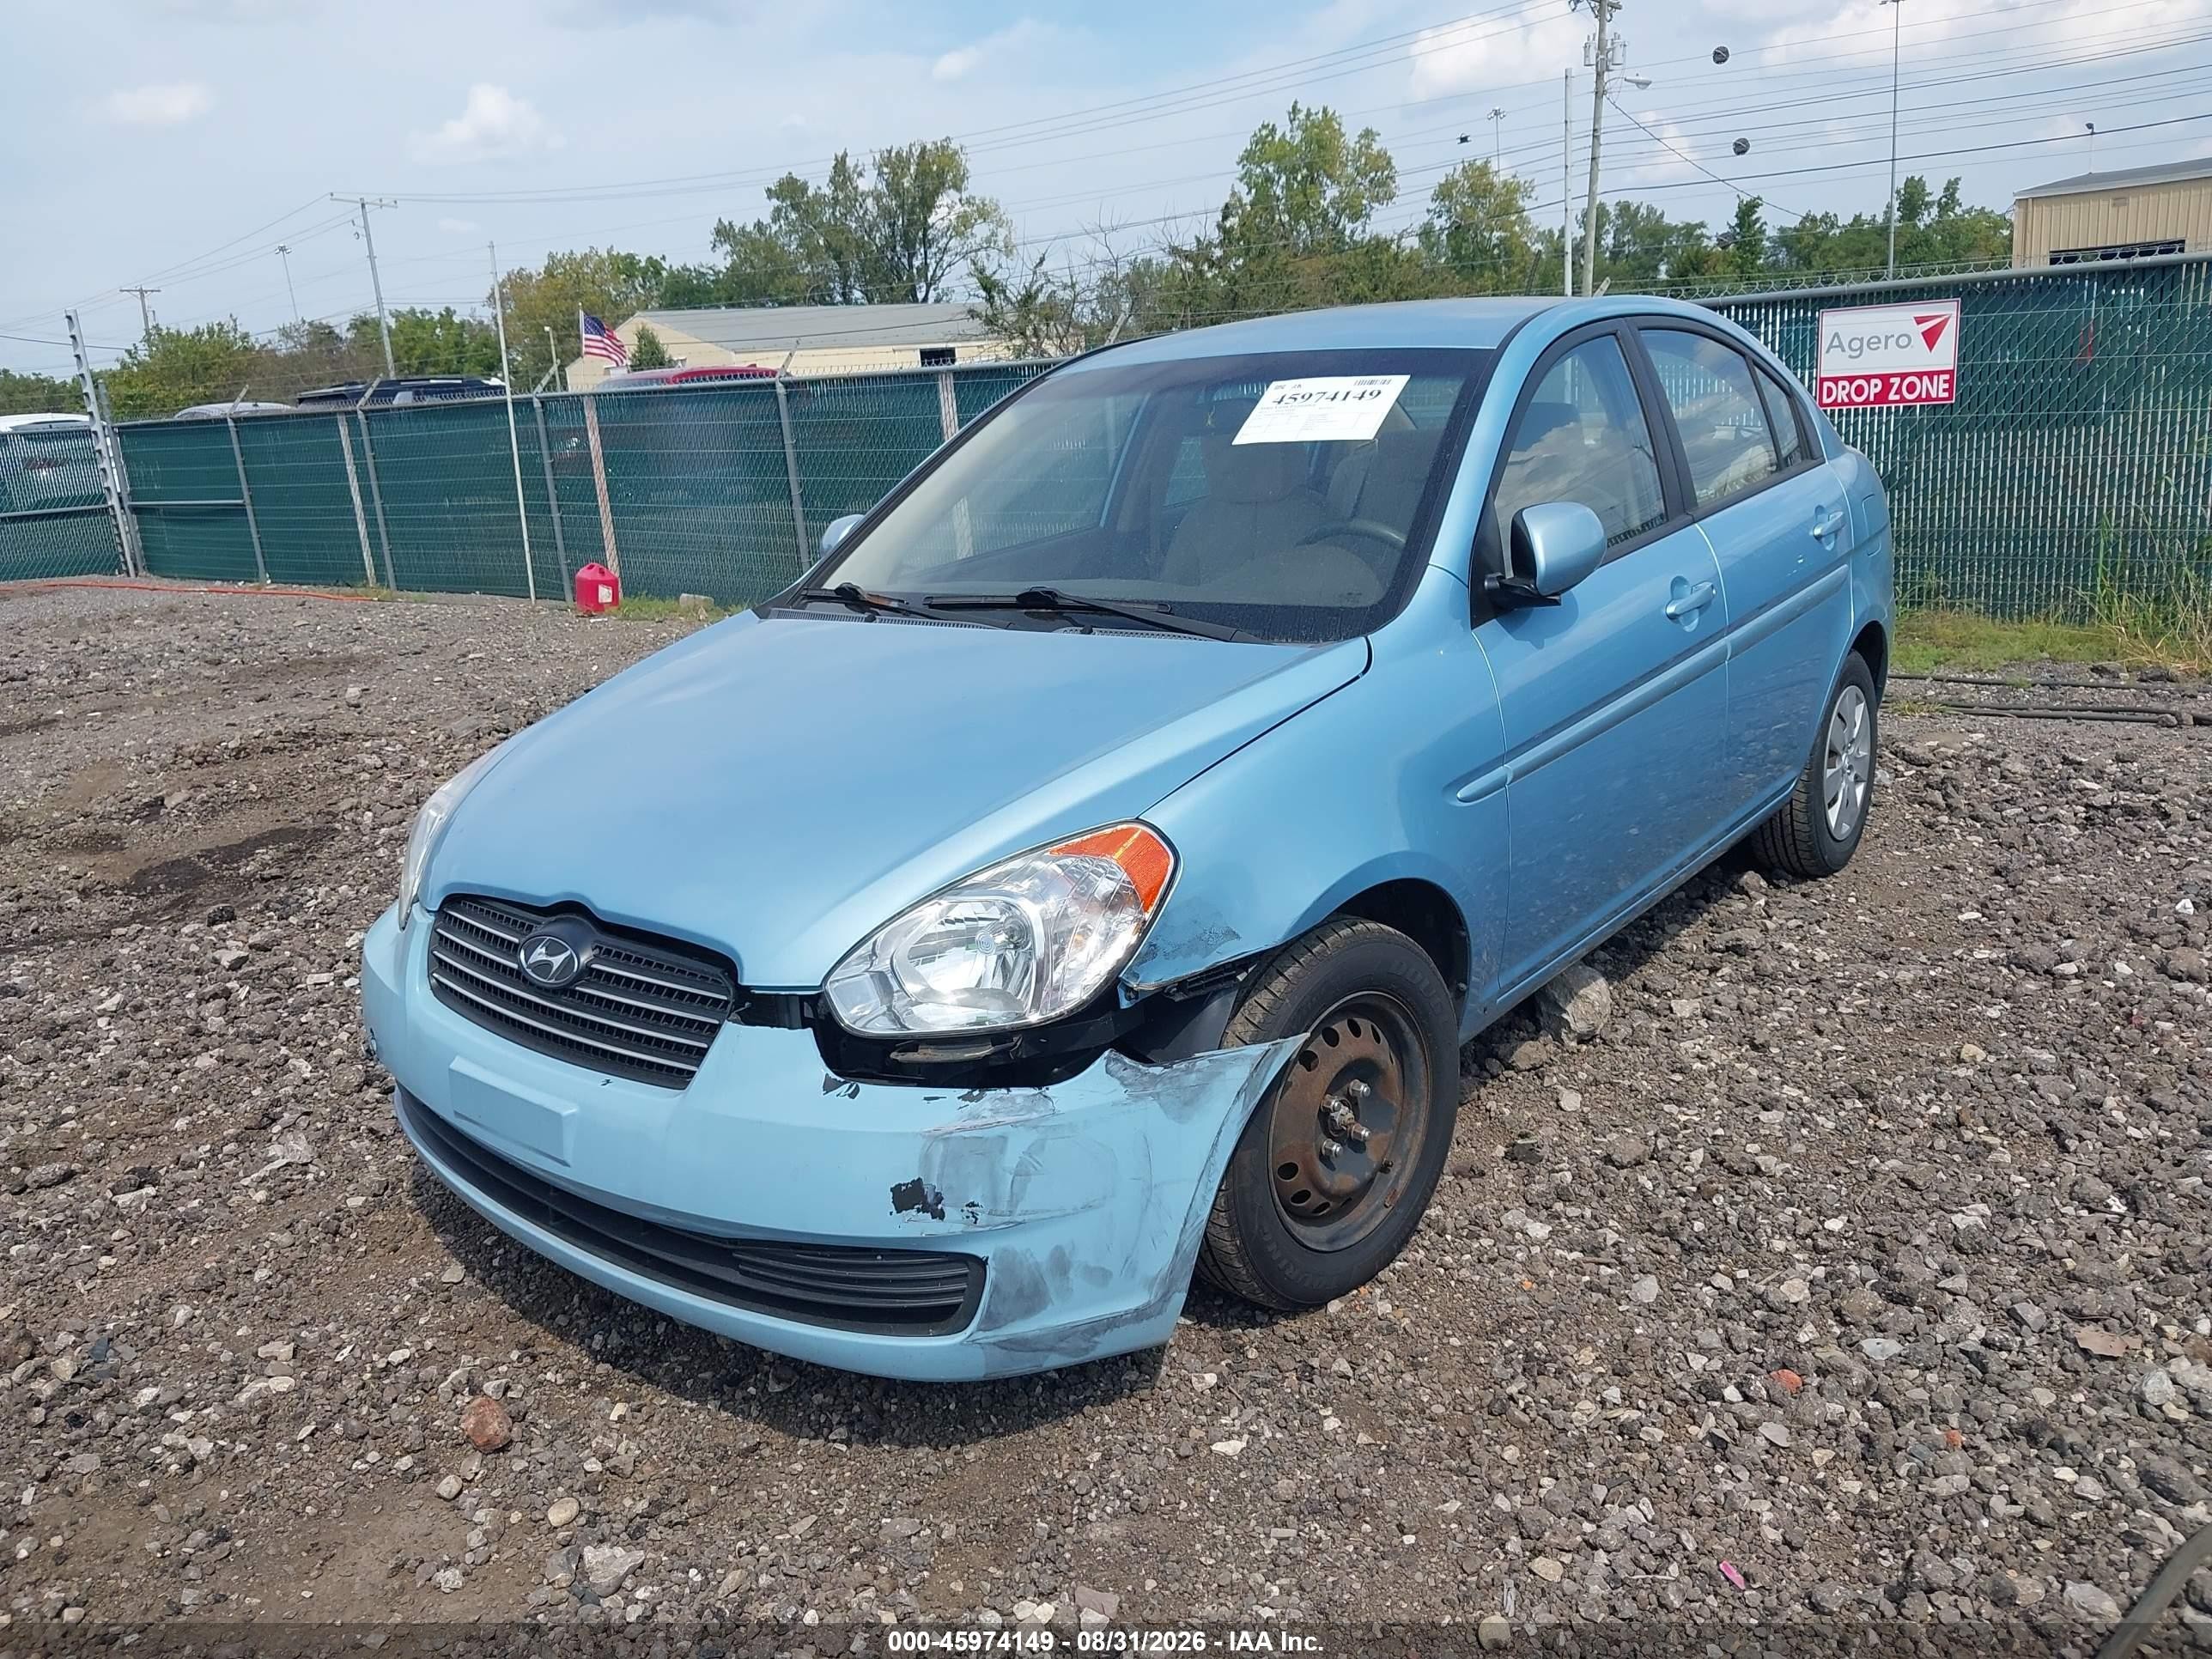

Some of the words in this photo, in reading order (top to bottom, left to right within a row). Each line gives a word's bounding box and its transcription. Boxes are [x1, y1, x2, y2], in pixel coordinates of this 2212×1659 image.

[1825, 331, 1913, 359] Agero
[1272, 389, 1382, 404] 45974149
[1821, 378, 1883, 404] DROP
[1887, 374, 1951, 401] ZONE
